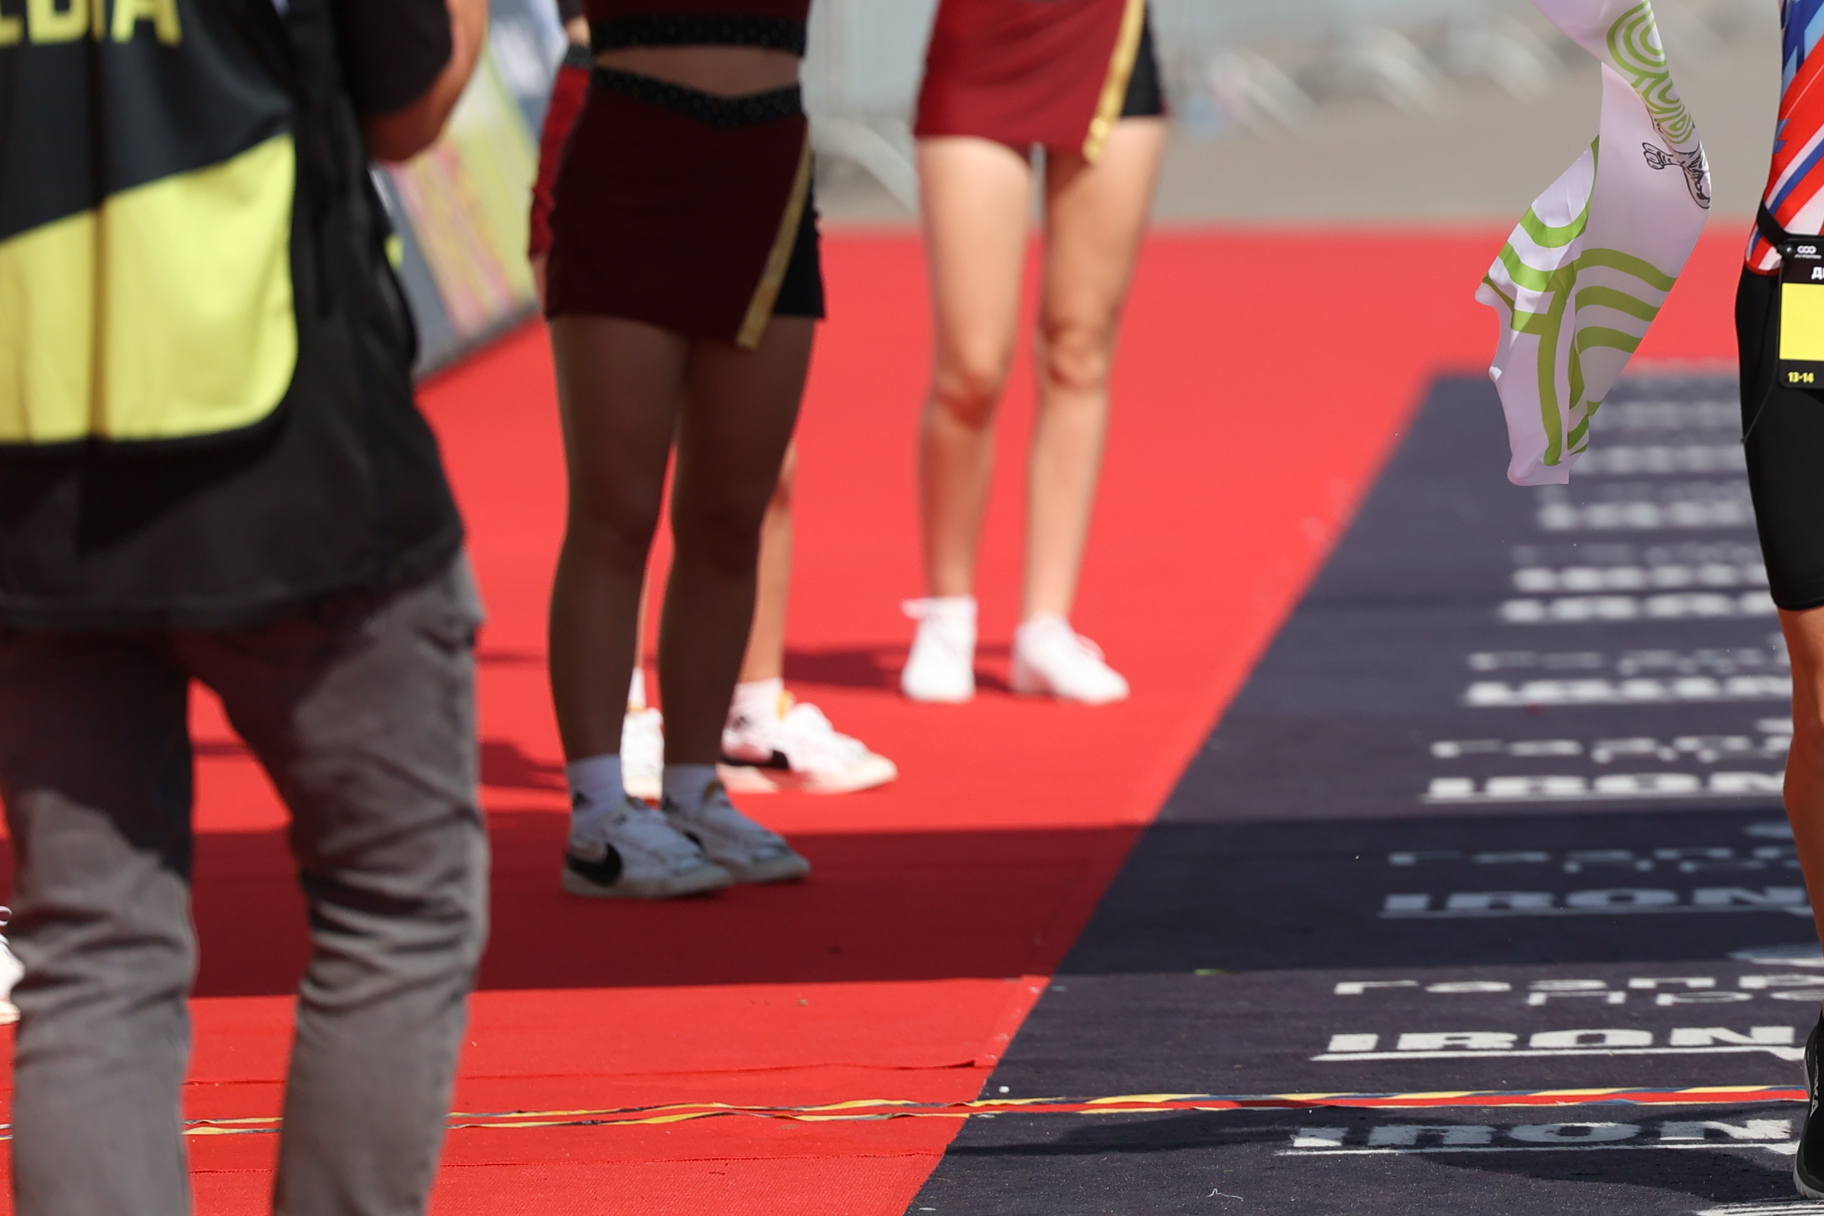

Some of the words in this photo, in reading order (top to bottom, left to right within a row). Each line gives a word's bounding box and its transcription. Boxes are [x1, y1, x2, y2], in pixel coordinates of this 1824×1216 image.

[1787, 371, 1815, 384] 13-14
[1327, 1026, 1795, 1052] IRON
[1292, 1120, 1791, 1147] IRON
